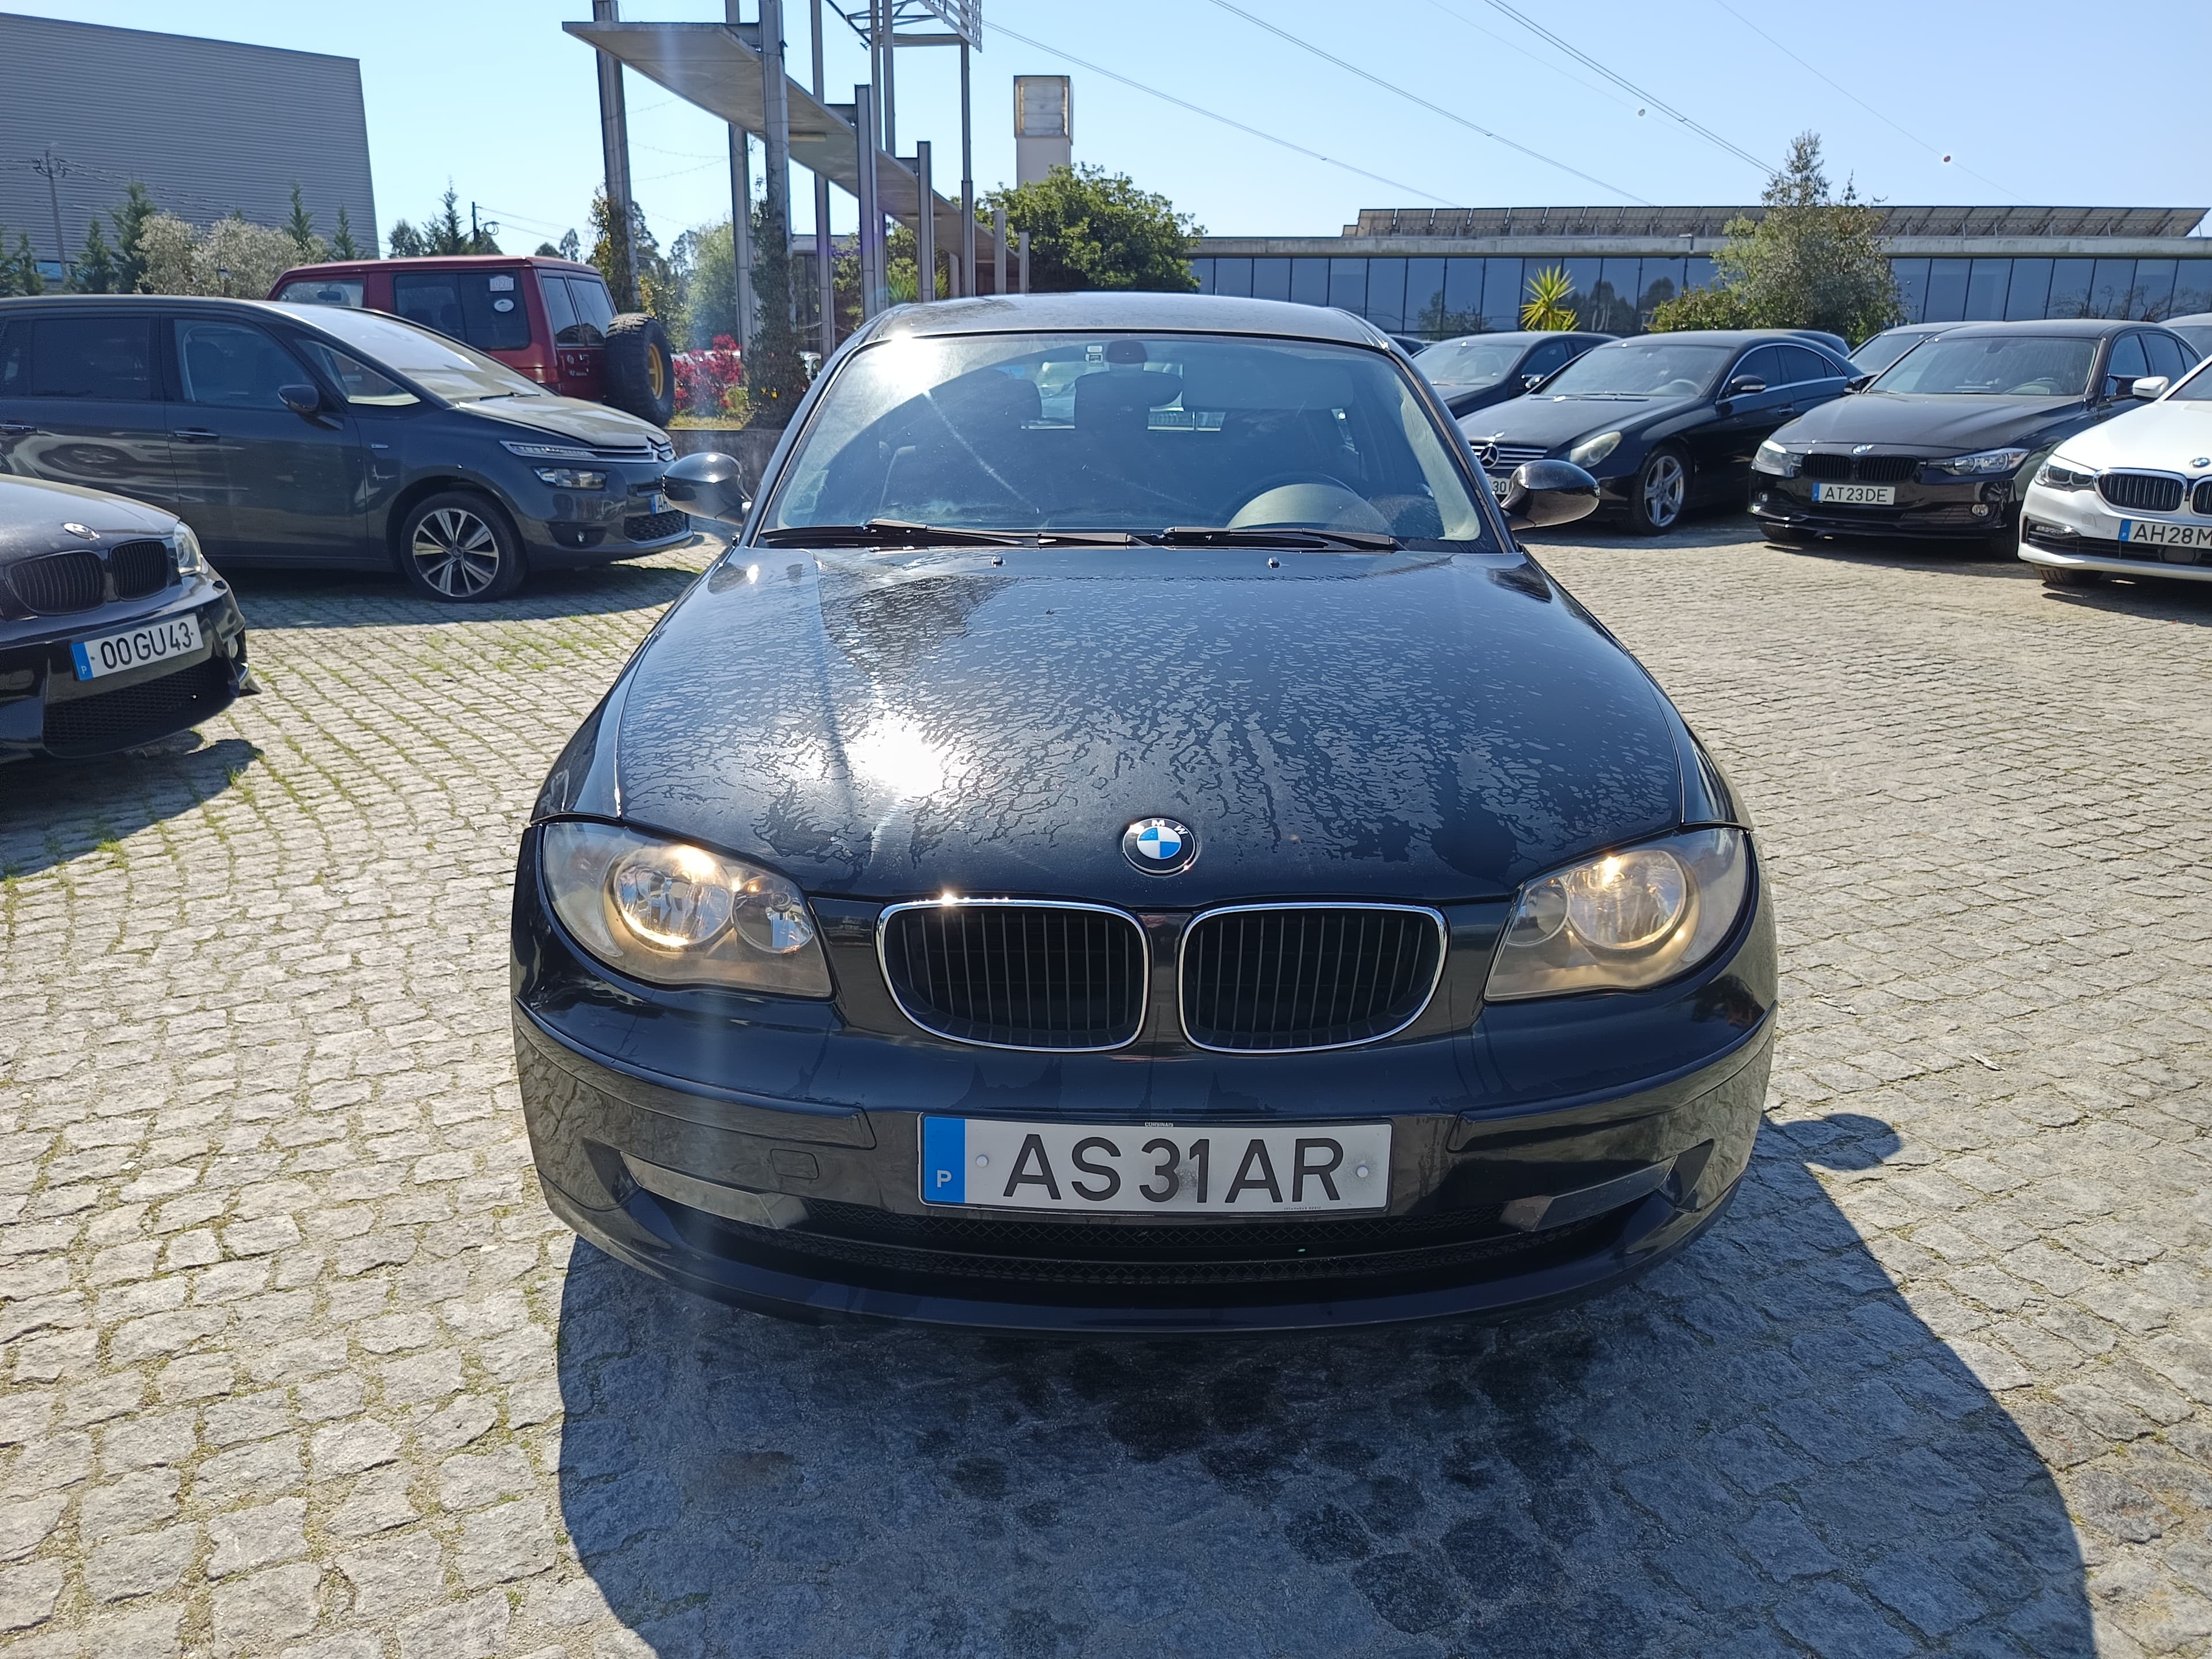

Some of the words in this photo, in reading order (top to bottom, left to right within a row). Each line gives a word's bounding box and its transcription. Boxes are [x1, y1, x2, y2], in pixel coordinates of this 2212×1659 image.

[1824, 486, 1888, 502] AT23DE
[937, 1170, 952, 1188] P
[1003, 1134, 1344, 1203] AS31AR
